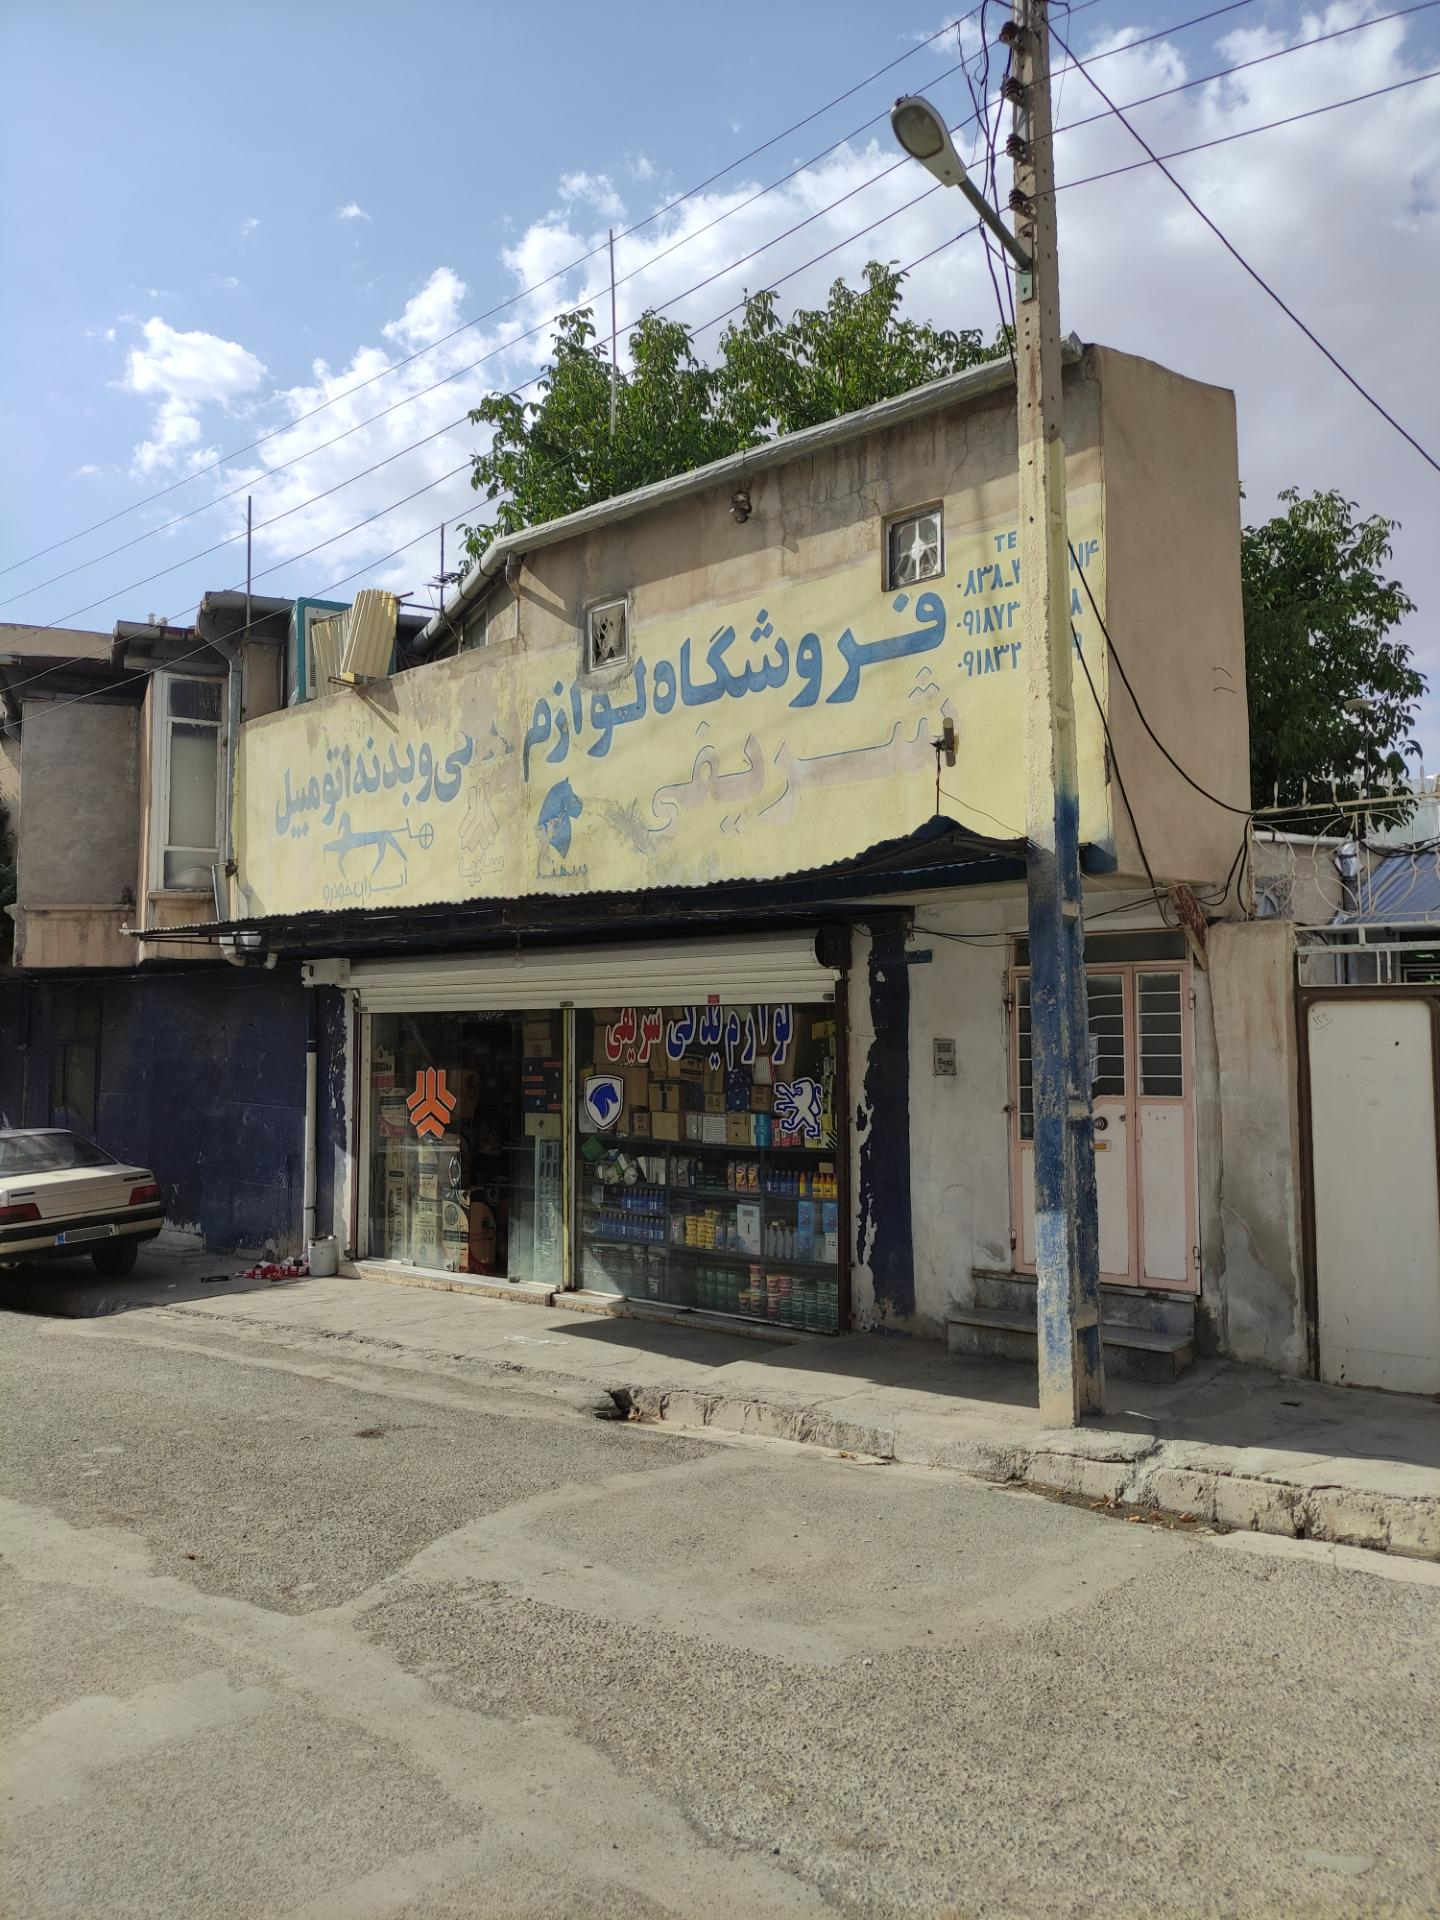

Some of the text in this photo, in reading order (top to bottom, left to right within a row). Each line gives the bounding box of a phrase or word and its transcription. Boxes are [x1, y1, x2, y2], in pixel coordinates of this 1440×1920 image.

[994, 531, 1018, 553] TE
[653, 592, 946, 714] فروشگاه
[523, 656, 646, 783] لوازم
[276, 744, 351, 838] اتومبیل
[353, 737, 415, 807] بدنه
[416, 743, 433, 802] و
